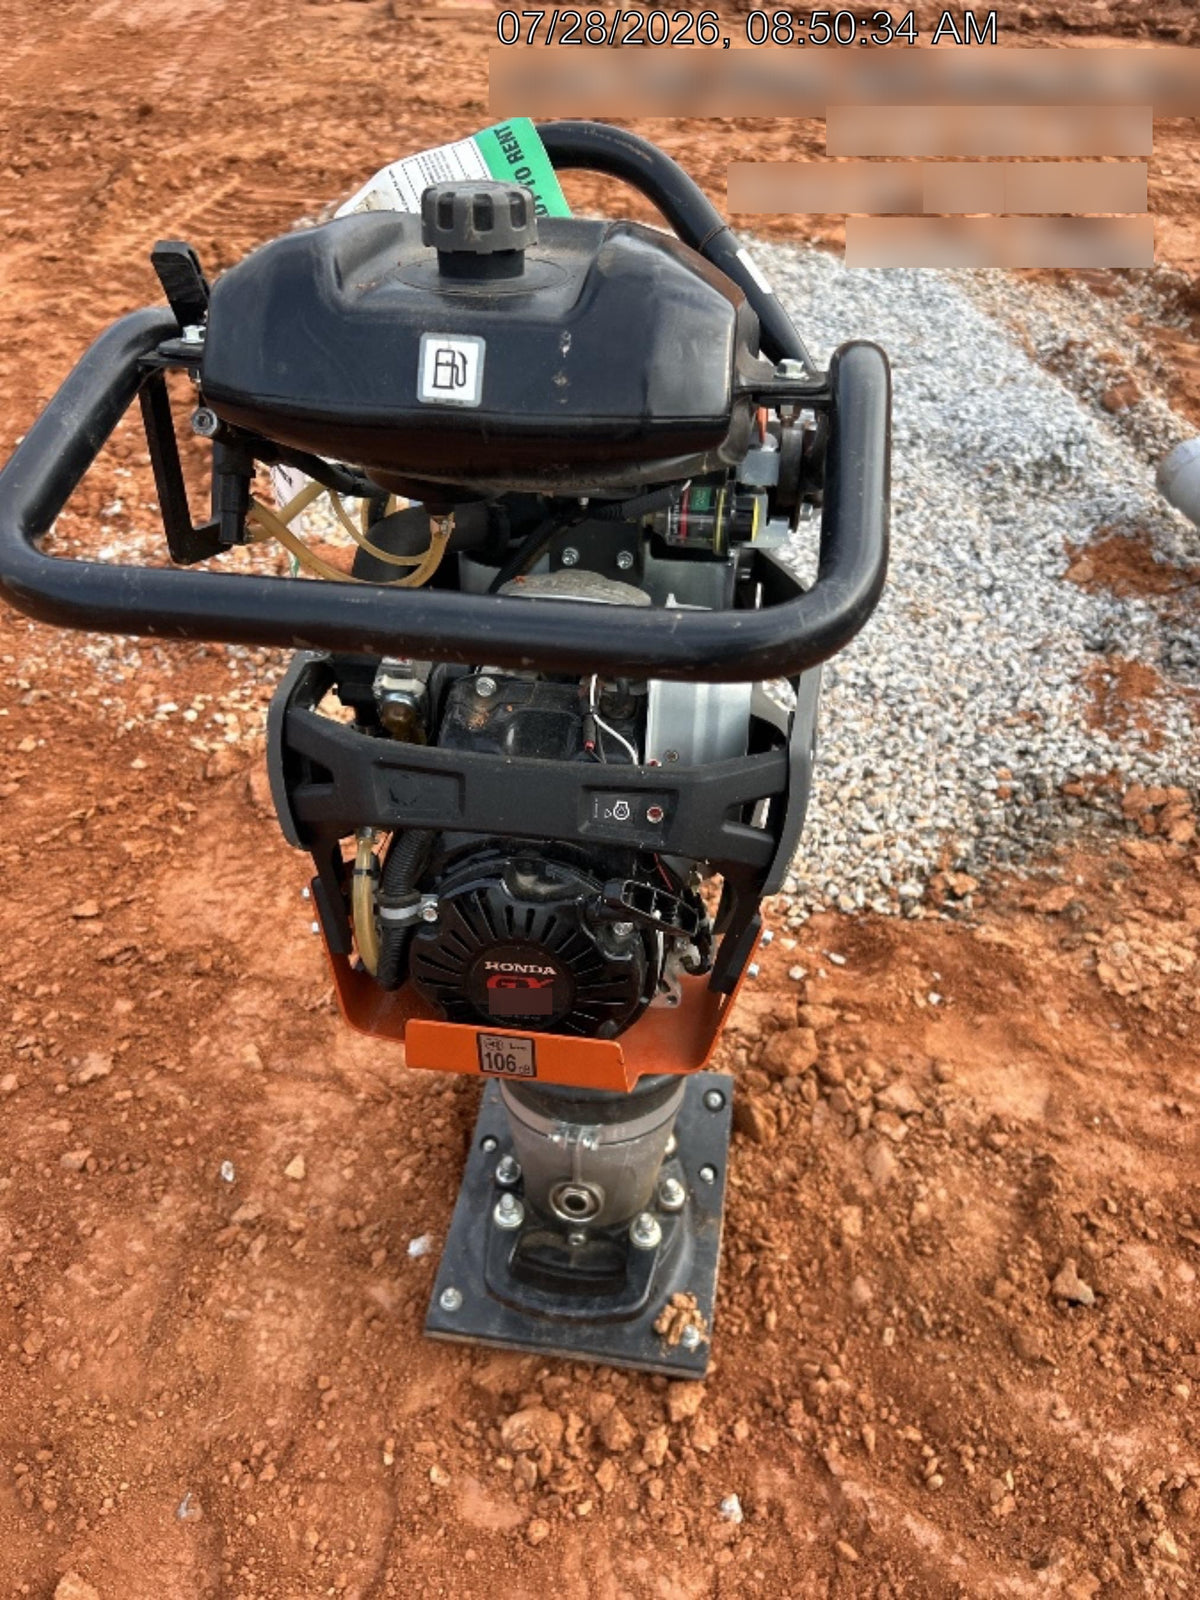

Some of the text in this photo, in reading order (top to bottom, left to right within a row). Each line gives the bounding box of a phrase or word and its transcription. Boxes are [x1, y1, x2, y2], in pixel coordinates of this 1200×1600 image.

[493, 125, 525, 165] RENT
[484, 961, 557, 975] HONDA
[484, 1052, 516, 1072] 106
